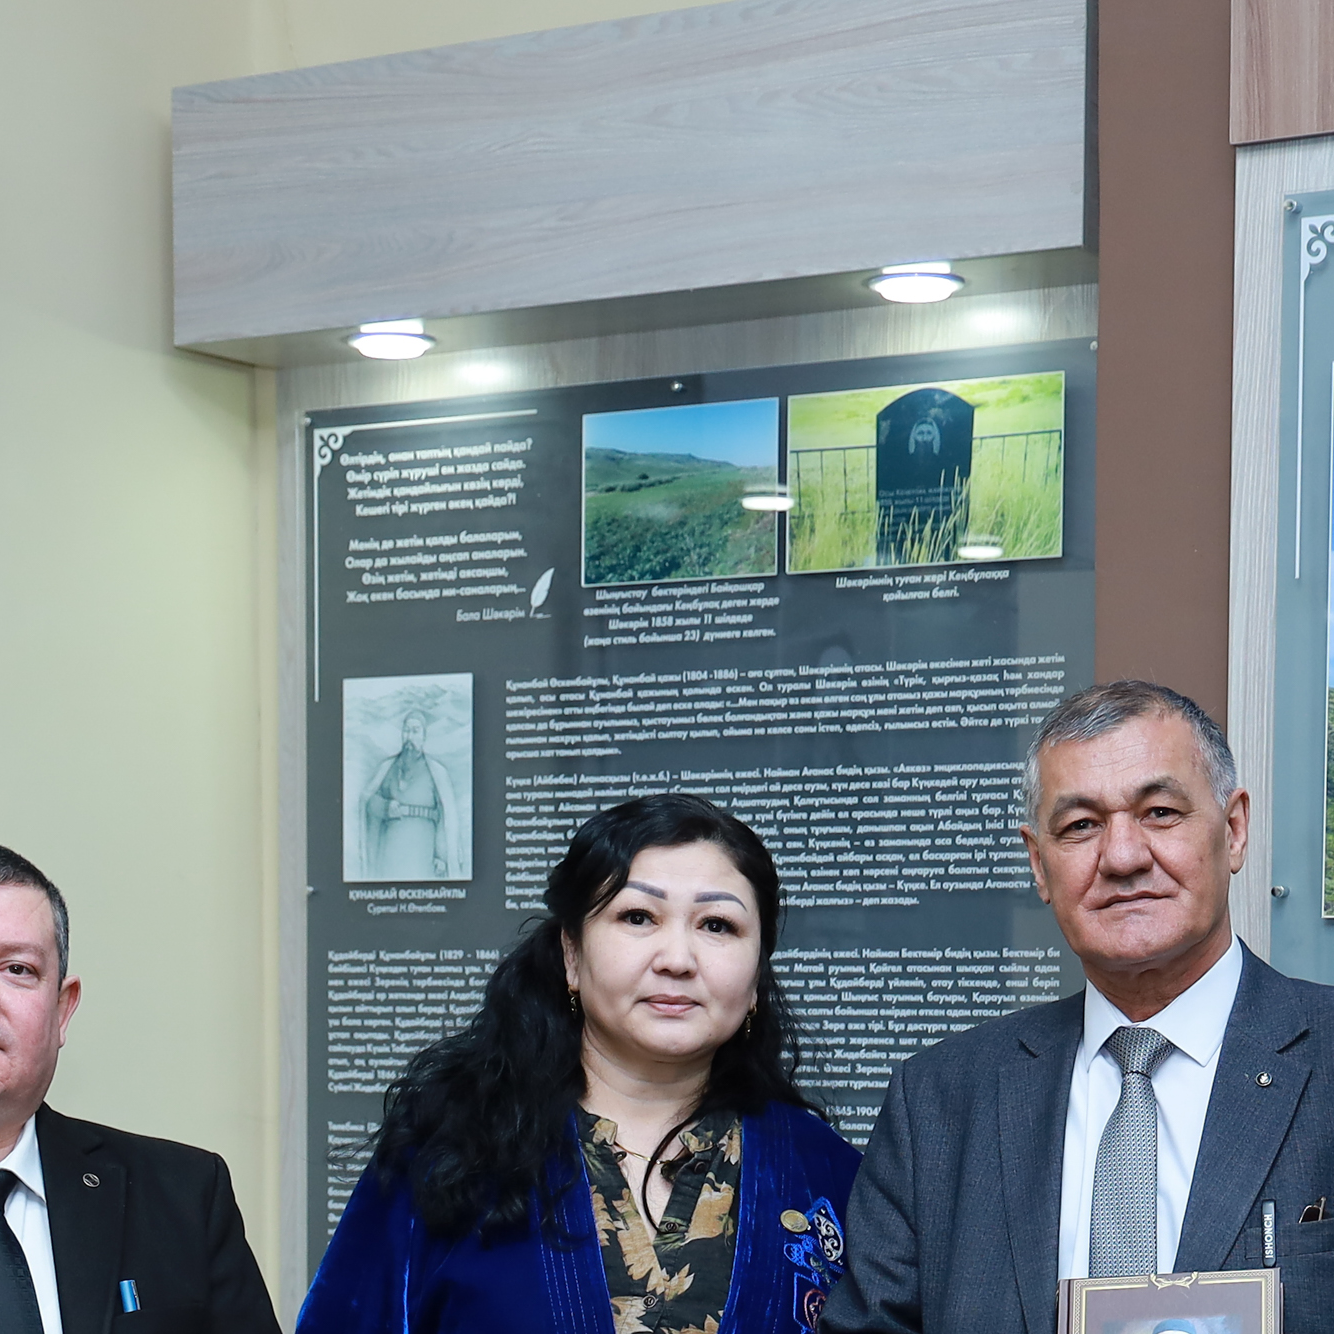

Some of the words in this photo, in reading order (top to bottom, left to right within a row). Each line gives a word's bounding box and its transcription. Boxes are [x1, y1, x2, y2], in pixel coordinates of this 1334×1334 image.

[651, 617, 674, 628] 1858
[704, 614, 712, 624] 11
[684, 629, 700, 642] 23)
[1264, 1214, 1273, 1259] ISHONCH
